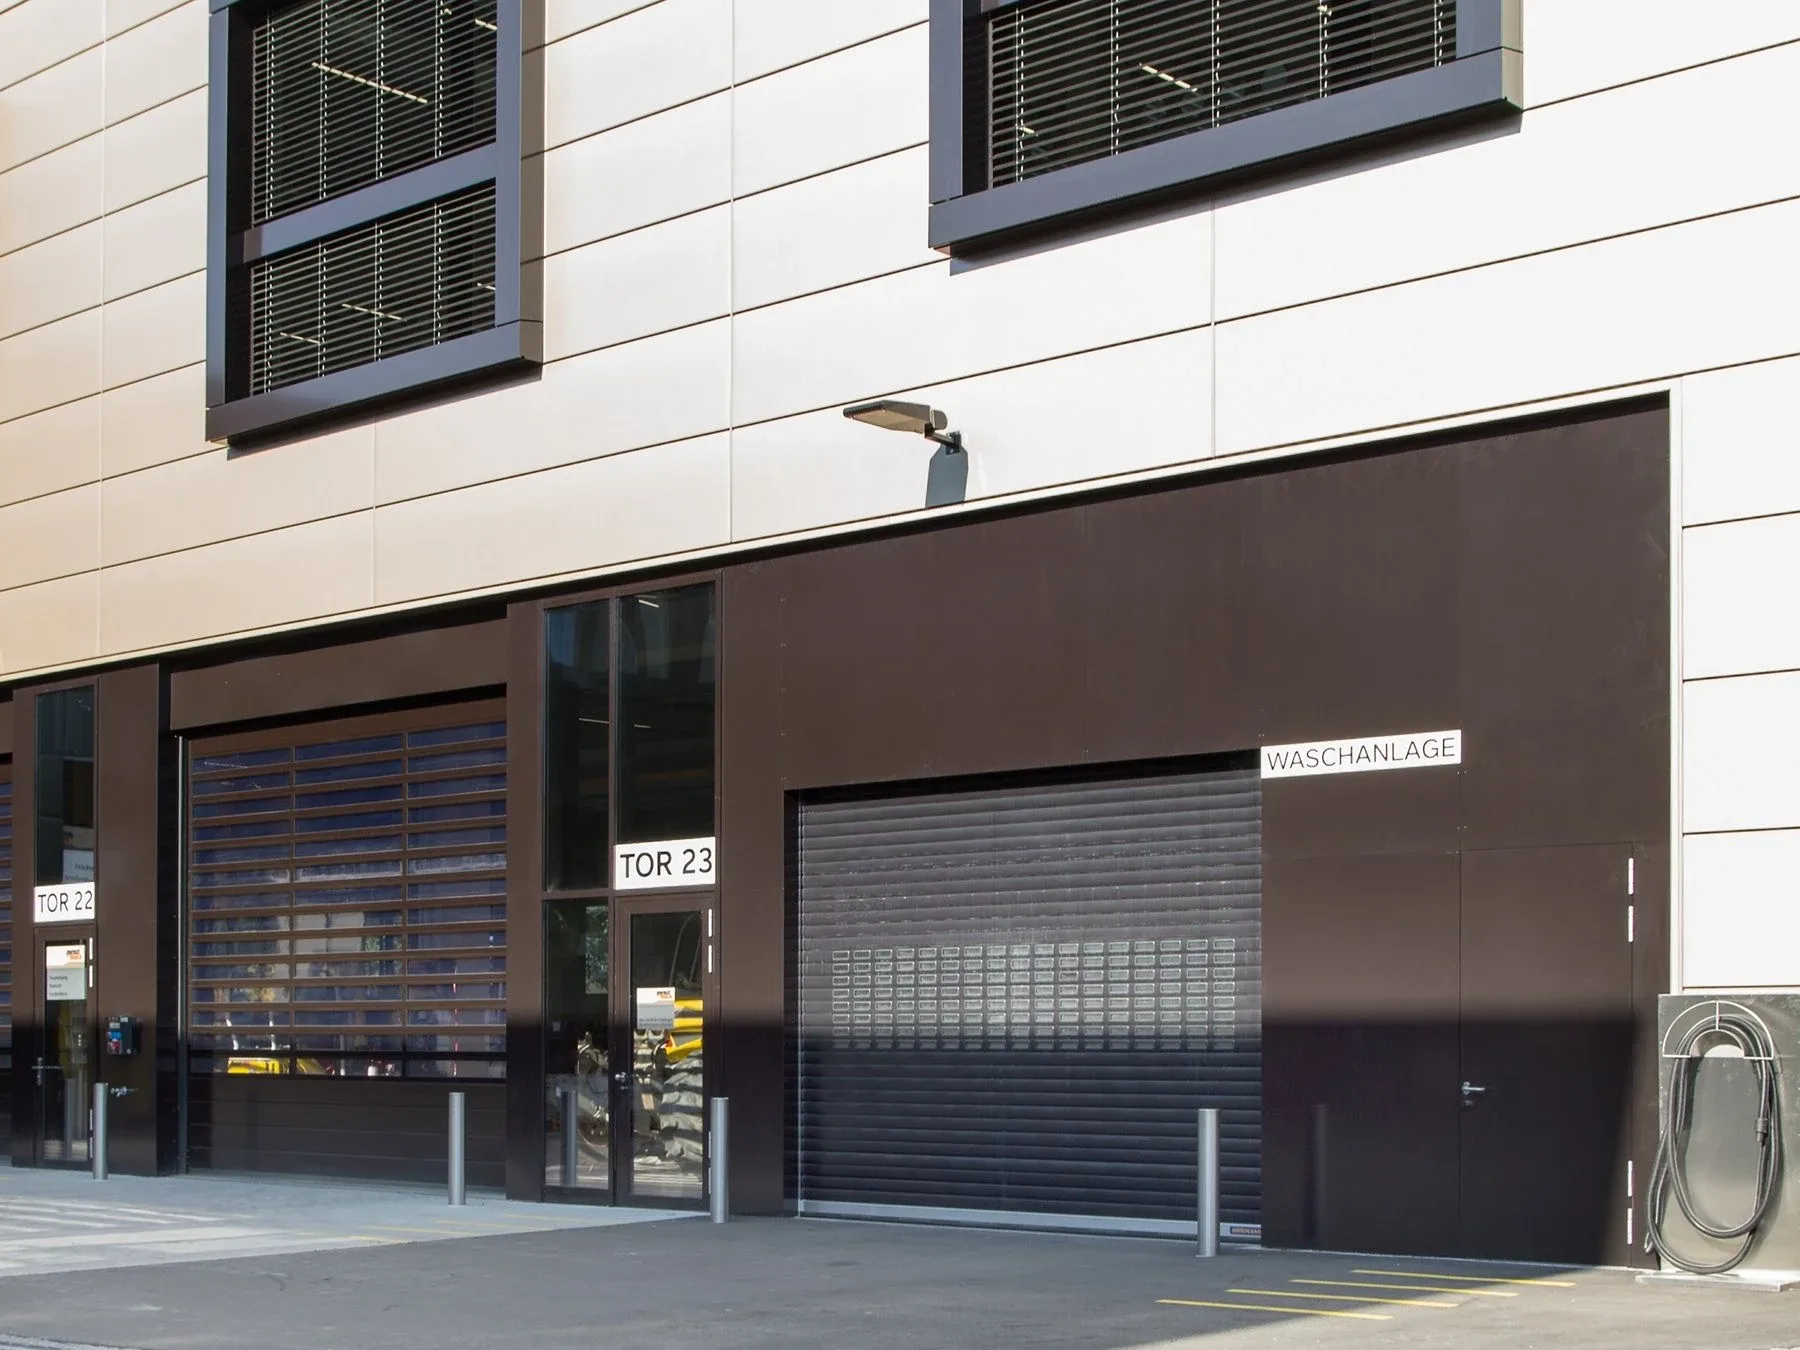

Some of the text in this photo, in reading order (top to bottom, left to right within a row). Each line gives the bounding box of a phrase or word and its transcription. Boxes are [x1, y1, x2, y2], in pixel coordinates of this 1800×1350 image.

[1267, 737, 1456, 771] WASCHANLAGE
[620, 847, 713, 878] TOR 23
[38, 891, 93, 913] TOR 22
